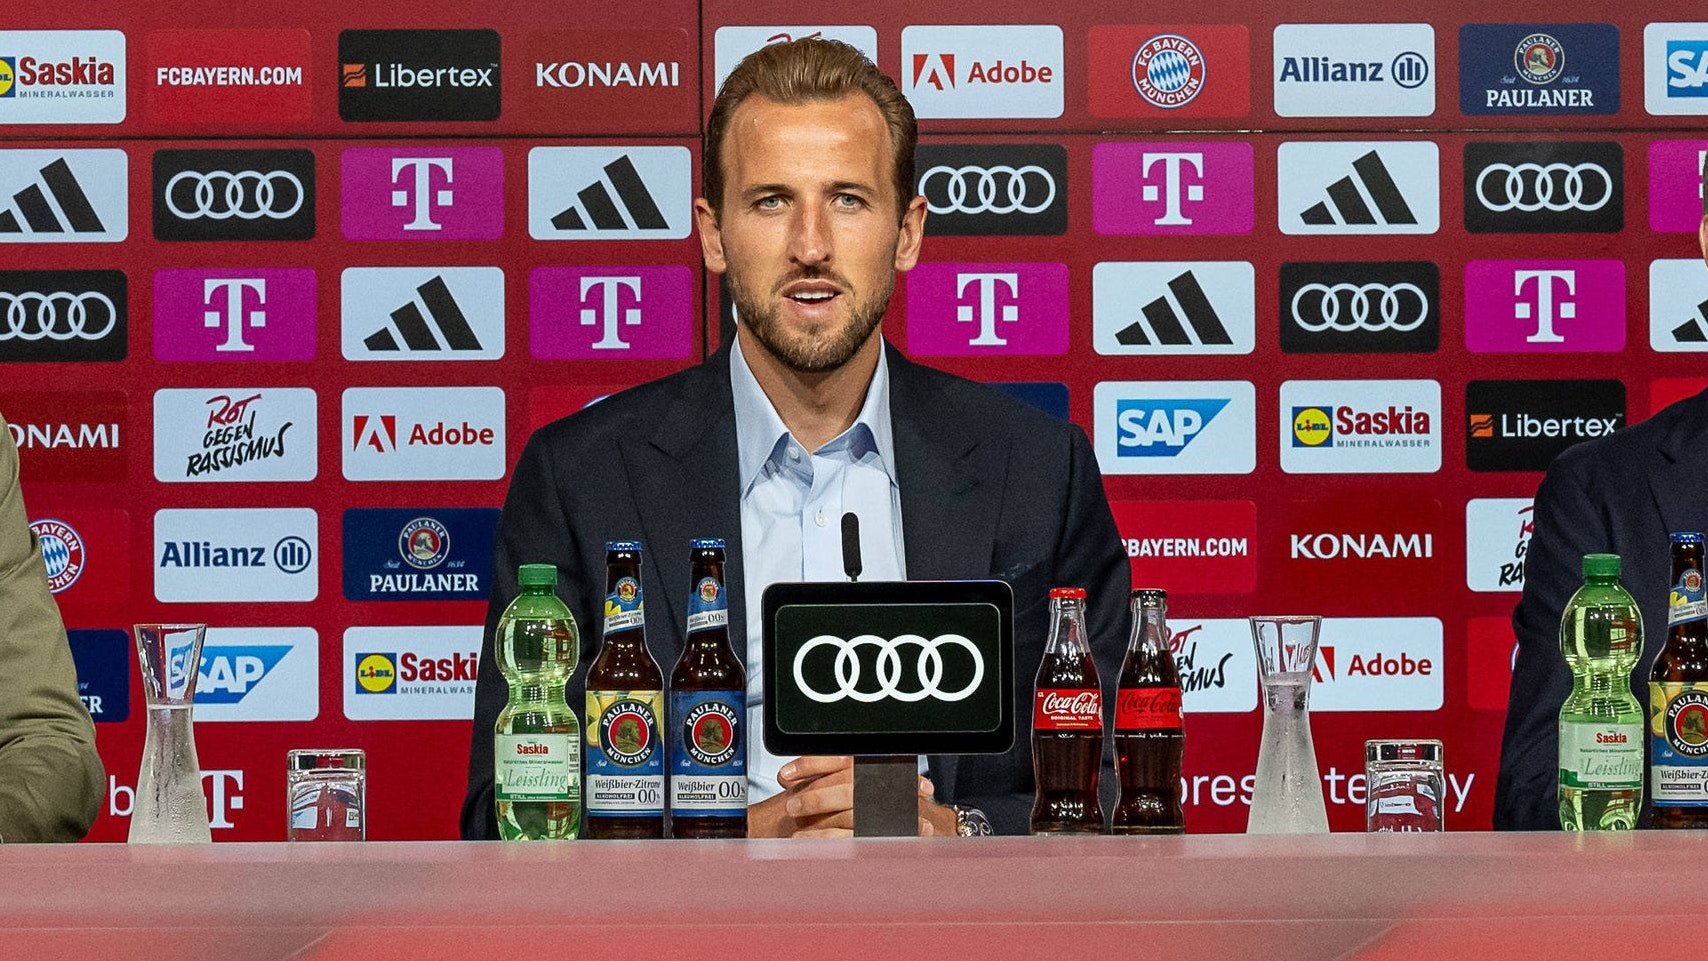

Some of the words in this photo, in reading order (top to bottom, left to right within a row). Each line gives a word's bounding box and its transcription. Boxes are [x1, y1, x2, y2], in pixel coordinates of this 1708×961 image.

[1138, 49, 1153, 66] FC
[1152, 38, 1200, 66] BAYERN
[1519, 37, 1560, 54] PAULANER
[19, 56, 115, 86] Saskia
[157, 67, 302, 86] FCBAYERN.COM
[536, 62, 679, 87] KONAMI
[967, 60, 1052, 84] Adobe
[1280, 57, 1384, 83] Allianz
[20, 90, 114, 98] MINERALWASSER
[1486, 89, 1594, 107] PAULANER
[206, 393, 263, 429] ROT
[1336, 405, 1431, 435] Saskia
[8, 424, 119, 448] ONAMI
[203, 410, 256, 449] GEGEN
[409, 423, 495, 446] Adobe
[1118, 409, 1202, 447] SAP
[186, 422, 293, 477] RASSISMUS
[1337, 439, 1430, 448] MINERALWASSER
[403, 521, 445, 538] PAULANER
[161, 541, 266, 568] Allianz
[1121, 538, 1248, 557] BAYERN.COM
[1290, 534, 1433, 559] KONAMI
[48, 563, 79, 590] CHEN
[370, 574, 479, 592] PAULANER
[401, 652, 477, 681] Saski
[1348, 653, 1432, 676] Adobe
[401, 686, 473, 694] MINERALWAS
[602, 703, 654, 727] PAULANER
[686, 703, 738, 727] PAULANER
[1043, 692, 1099, 715] Coca-Cola
[1668, 695, 1708, 718] PAULAN
[517, 743, 549, 754] Saskia
[1596, 733, 1627, 743] Saskia
[506, 768, 567, 792] Leissling
[678, 781, 715, 793] Weißbier
